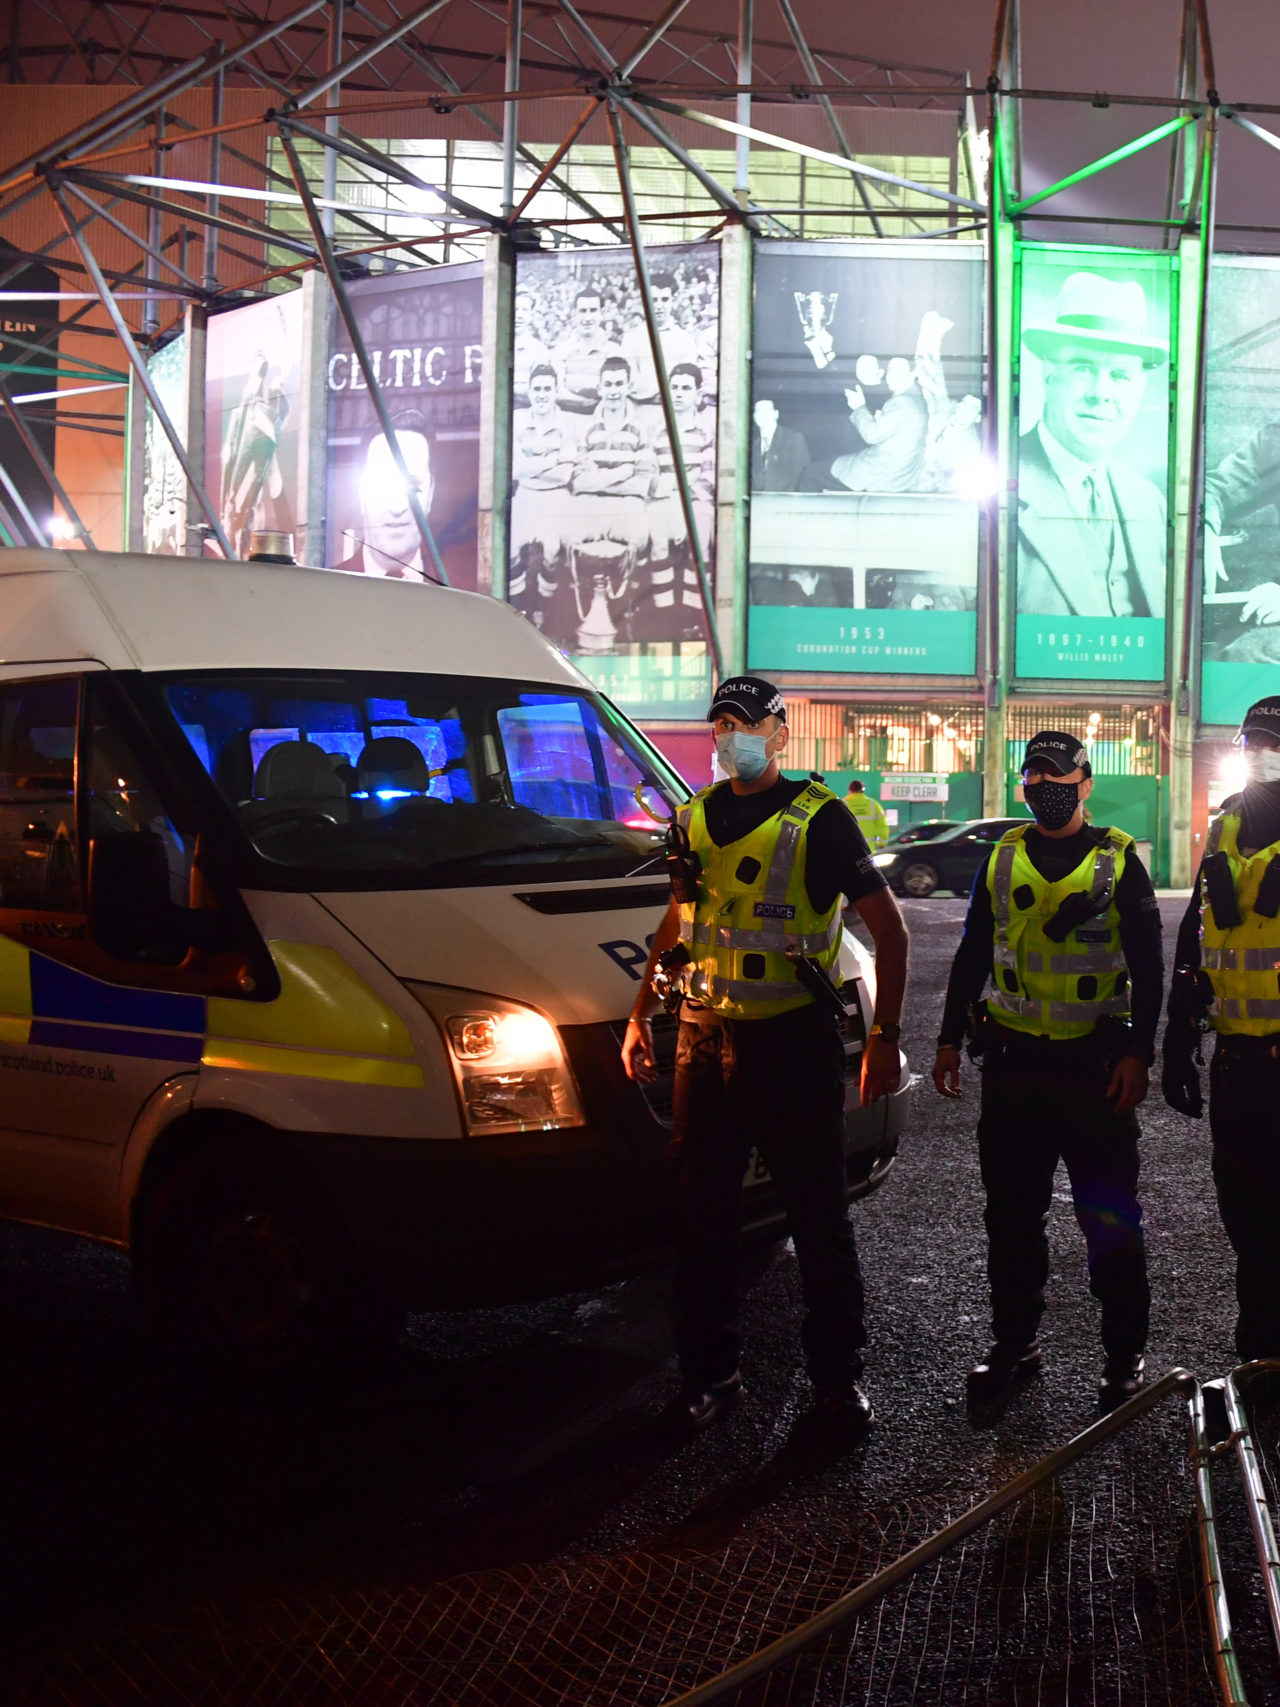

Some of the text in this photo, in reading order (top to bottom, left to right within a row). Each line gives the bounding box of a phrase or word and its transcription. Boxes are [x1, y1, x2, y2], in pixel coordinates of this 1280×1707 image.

[328, 347, 446, 390] CELTIC
[840, 626, 885, 640] 1953
[862, 645, 880, 655] CUP
[718, 683, 760, 698] POLICE
[1031, 740, 1068, 751] POLICE
[891, 786, 938, 799] KEEP CLEAR
[756, 905, 793, 919] POLICE
